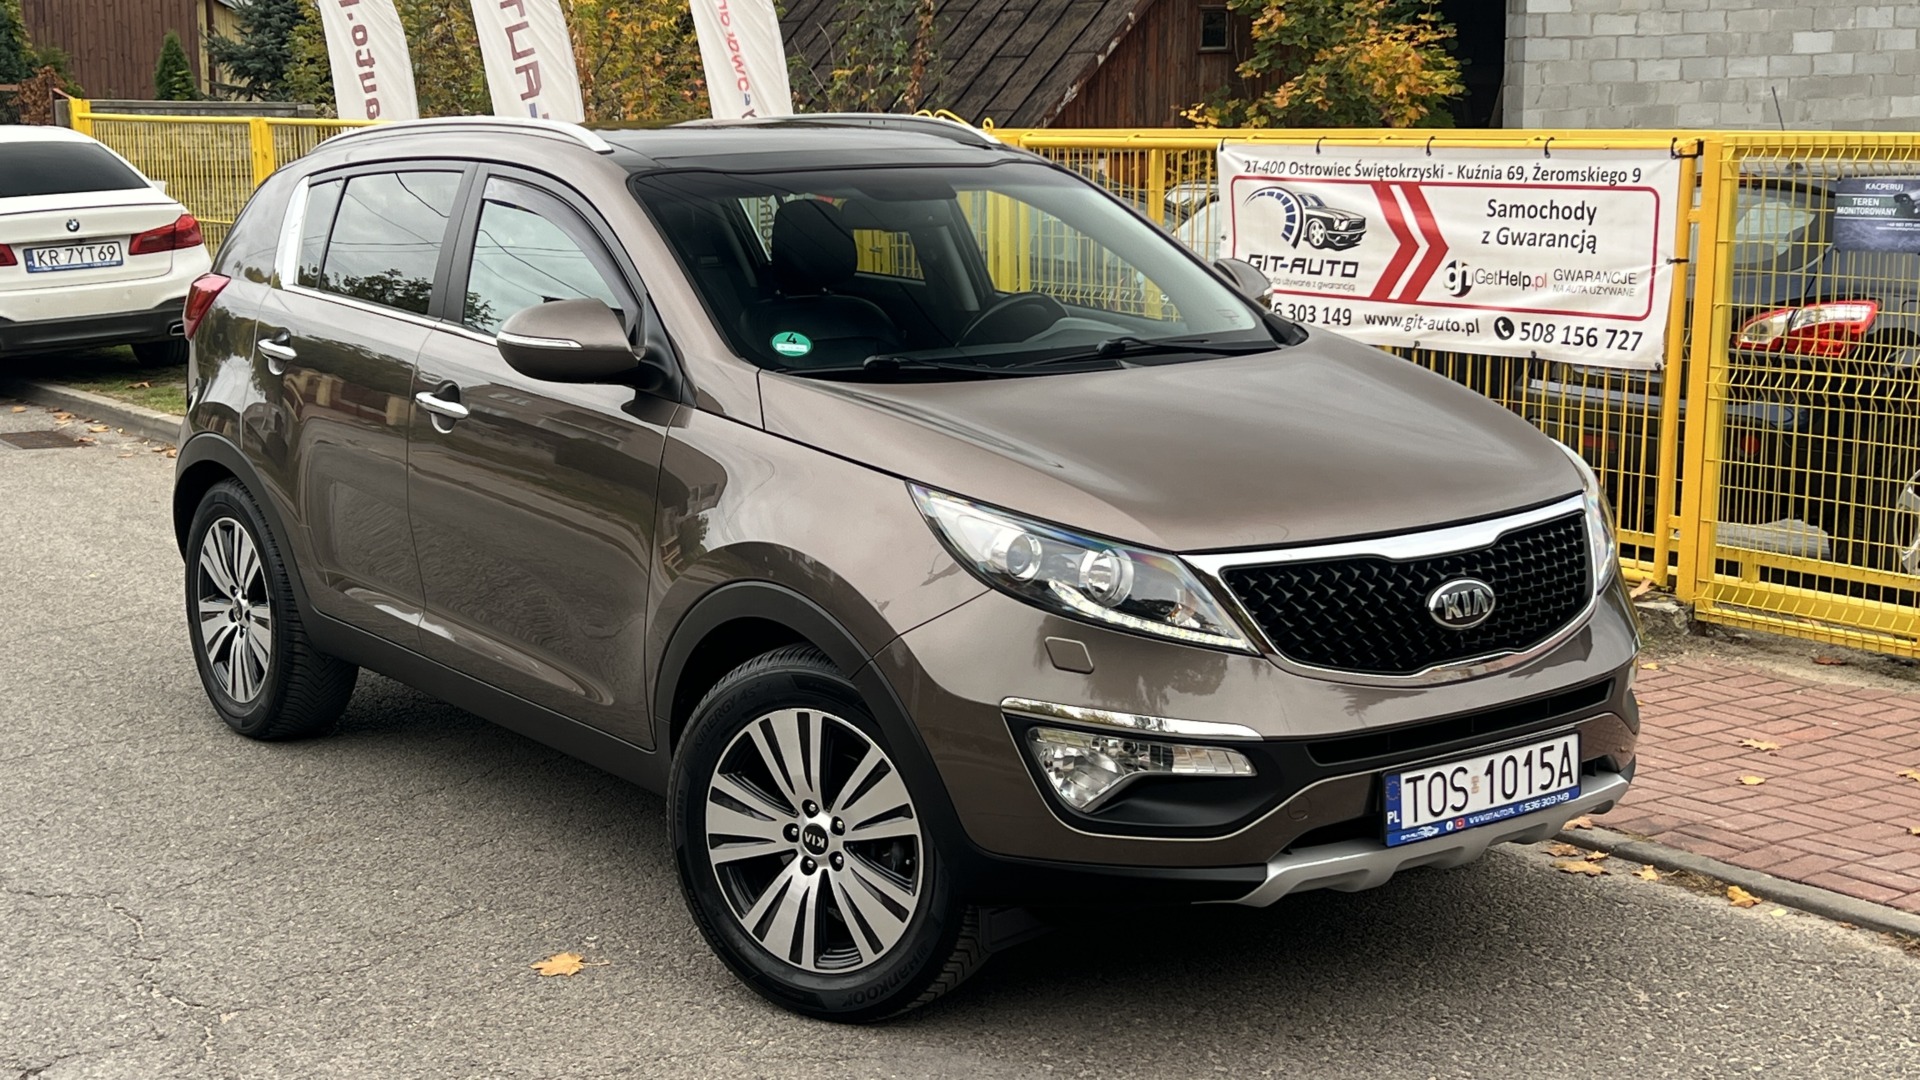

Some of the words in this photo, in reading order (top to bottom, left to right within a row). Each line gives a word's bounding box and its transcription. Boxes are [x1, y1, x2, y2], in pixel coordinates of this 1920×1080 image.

[1243, 160, 1286, 175] 27-400
[1289, 161, 1351, 177] Ostrowiec
[1354, 159, 1444, 182] Świętokrzyski
[1457, 164, 1503, 180] Kuźnia
[1507, 165, 1528, 183] 69,
[1532, 162, 1628, 186] Żeromskiego
[1632, 167, 1641, 183] 9
[1865, 183, 1904, 191] KACPERUJ
[1486, 198, 1597, 225] Samochody
[1836, 206, 1897, 216] MONITOROWANY
[1852, 197, 1880, 206] TEREN
[1481, 230, 1491, 245] z
[1496, 227, 1597, 254] Gwarancją
[36, 249, 60, 266] KR
[65, 245, 116, 263] 7YT69
[1247, 253, 1359, 278] GIT-AUTO
[1475, 268, 1547, 290] GetHelp.pl
[1553, 269, 1637, 285] GWARANCJE
[1566, 285, 1588, 294] AUTA
[1288, 303, 1316, 323] 303
[1323, 306, 1352, 326] 149
[1364, 312, 1480, 336] www.git-auto.pl
[785, 332, 797, 344] 4
[1519, 322, 1556, 343] 508
[1560, 325, 1598, 348] 156
[1605, 329, 1643, 351] 727
[1441, 588, 1488, 620] KIA
[1405, 766, 1469, 823] TOS
[1484, 740, 1574, 804] 1015A
[1387, 810, 1400, 825] PL
[804, 831, 825, 848] KIA
